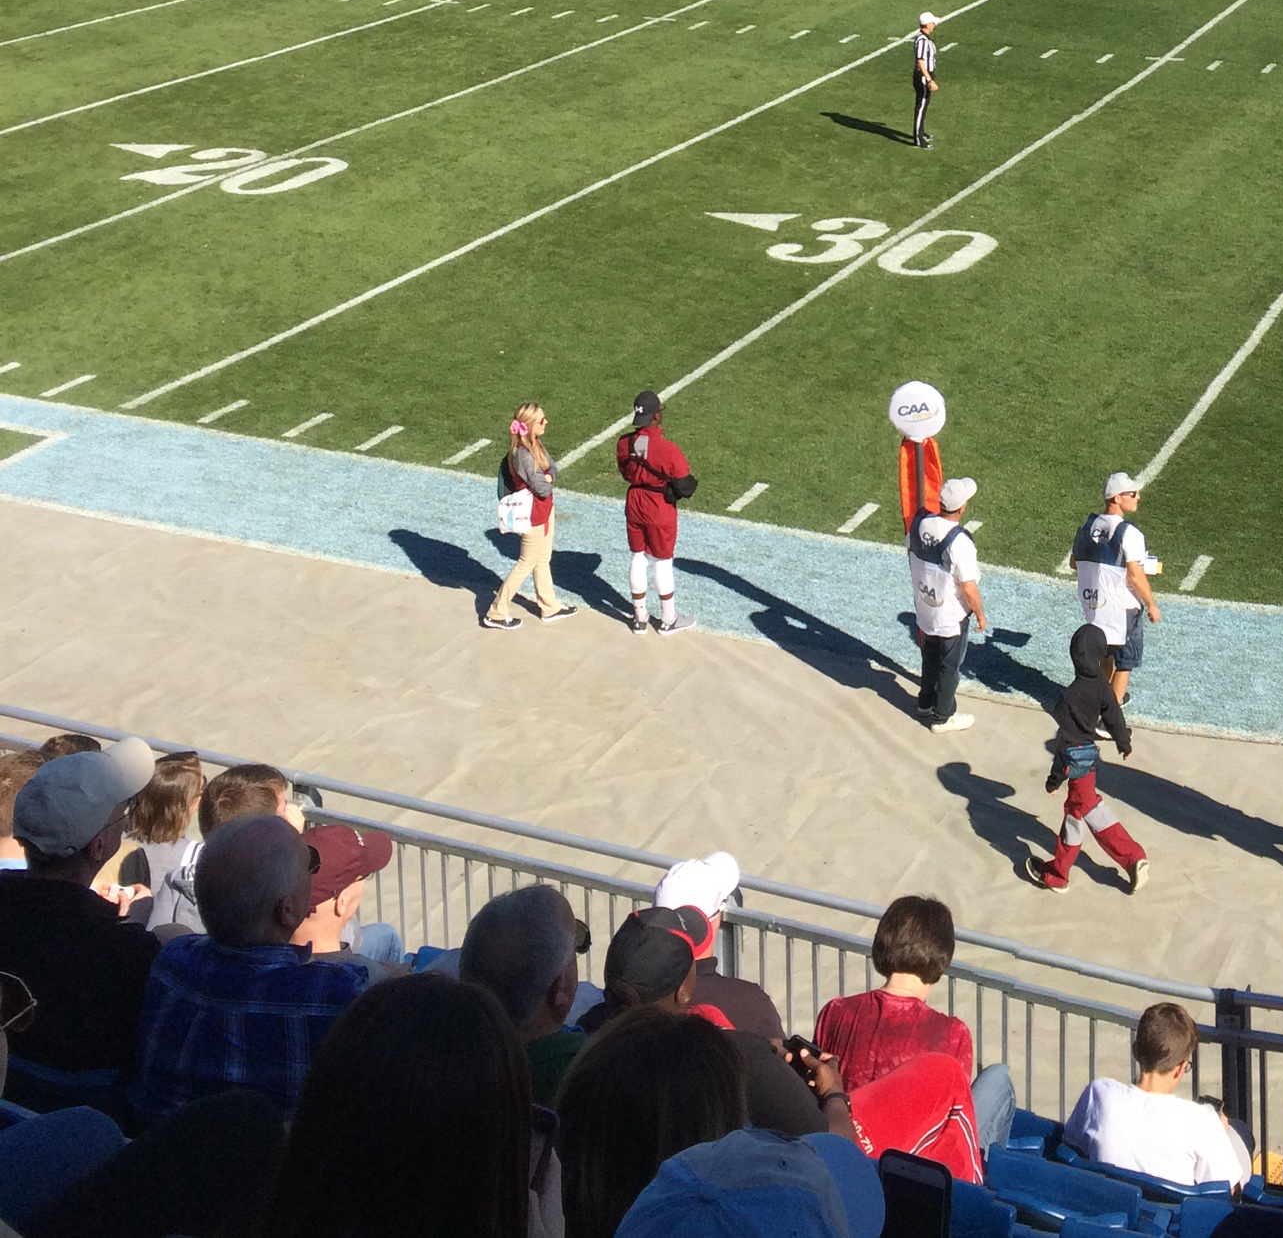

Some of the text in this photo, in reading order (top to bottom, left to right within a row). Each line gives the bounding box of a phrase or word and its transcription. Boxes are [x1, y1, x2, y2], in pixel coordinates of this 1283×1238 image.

[120, 147, 349, 195] 20
[766, 217, 999, 276] 30
[898, 402, 930, 416] CAA
[918, 580, 936, 600] CAA
